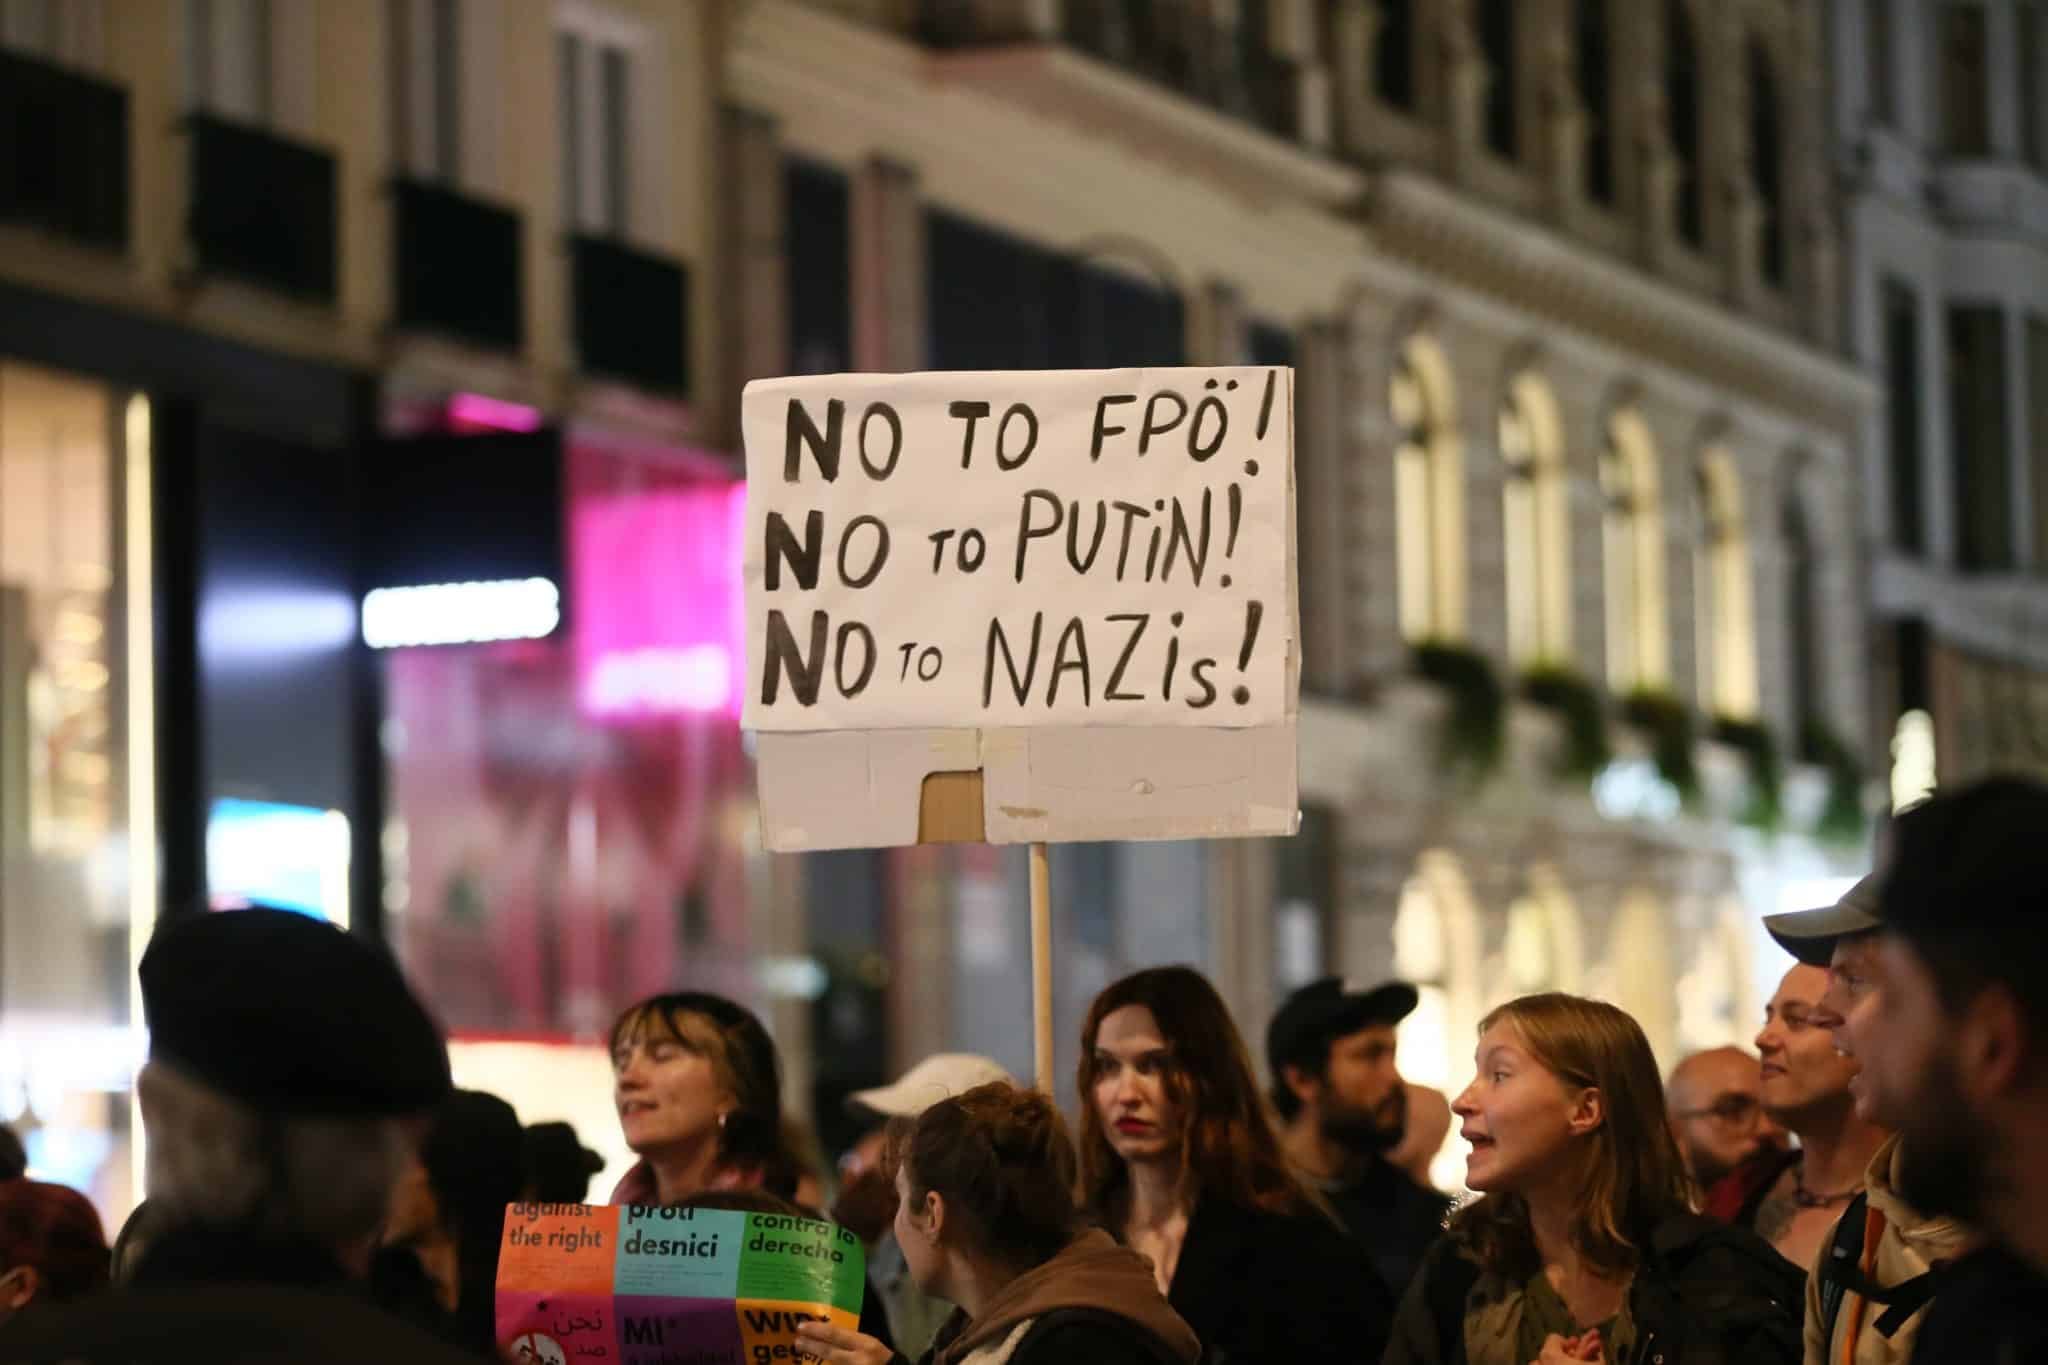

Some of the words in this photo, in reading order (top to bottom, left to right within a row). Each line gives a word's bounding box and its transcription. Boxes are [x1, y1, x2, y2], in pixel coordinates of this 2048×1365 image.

[784, 398, 903, 483] NO
[949, 400, 1039, 472] TO
[1090, 369, 1276, 477] FPÖ!
[765, 509, 890, 592] NO
[928, 528, 986, 574] TO
[761, 609, 877, 708] NO
[899, 642, 943, 682] TO
[513, 1203, 592, 1221] against
[510, 1226, 541, 1246] the
[548, 1224, 602, 1252] right
[625, 1229, 718, 1257] desnici
[753, 1215, 830, 1237] contra
[836, 1223, 857, 1246] la
[749, 1233, 844, 1262] derecha
